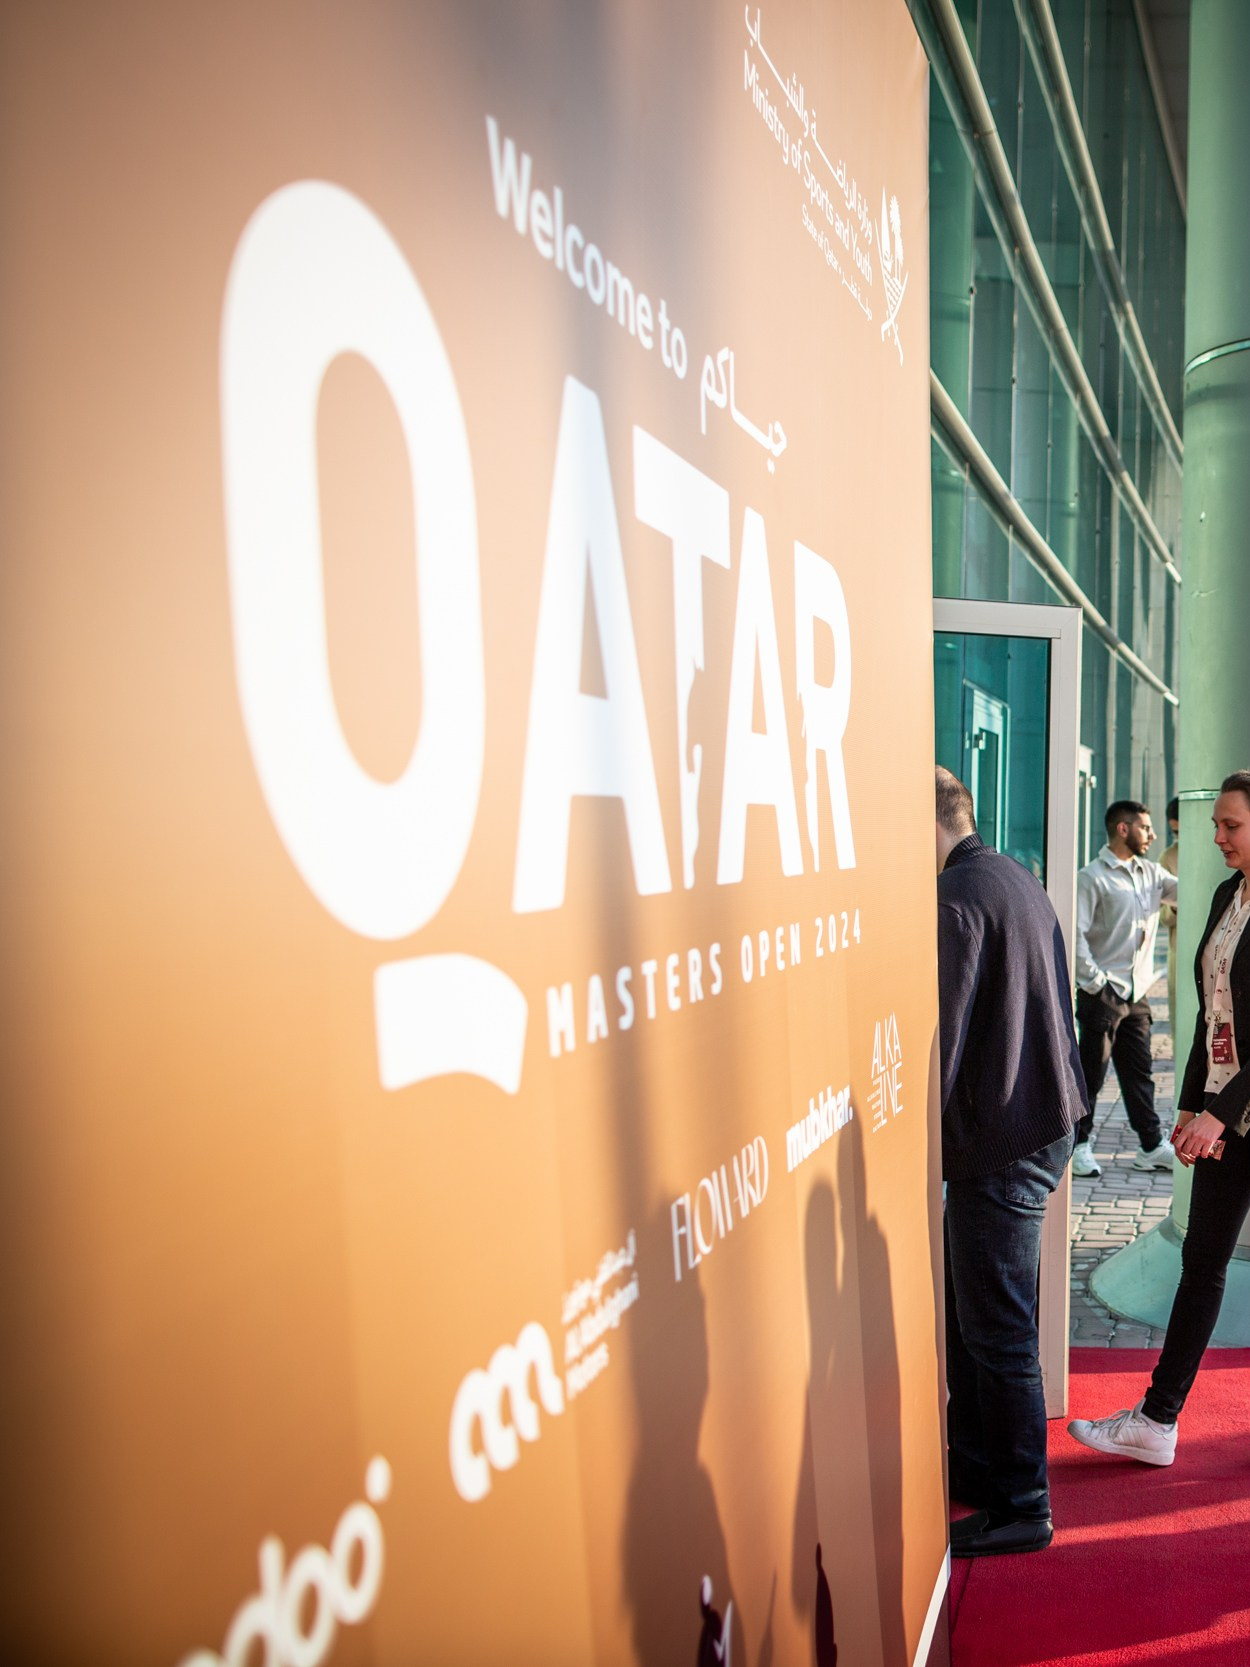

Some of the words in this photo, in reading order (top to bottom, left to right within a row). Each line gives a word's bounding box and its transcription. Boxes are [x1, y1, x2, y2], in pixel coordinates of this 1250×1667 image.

[743, 48, 789, 166] Ministry
[791, 137, 803, 175] of
[803, 149, 834, 227] Sports
[834, 212, 849, 251] and
[850, 222, 872, 287] Youth
[801, 202, 818, 242] State
[817, 230, 825, 251] of
[824, 236, 839, 273] Qatar
[486, 114, 654, 351] Welcome
[658, 297, 688, 380] to
[218, 178, 858, 1096] QATAR
[546, 942, 723, 1058] MASTERS
[740, 922, 801, 984] OPEN
[814, 908, 861, 958] 2024
[871, 1011, 902, 1079] ALKA
[670, 1135, 769, 1283] FLOWARD
